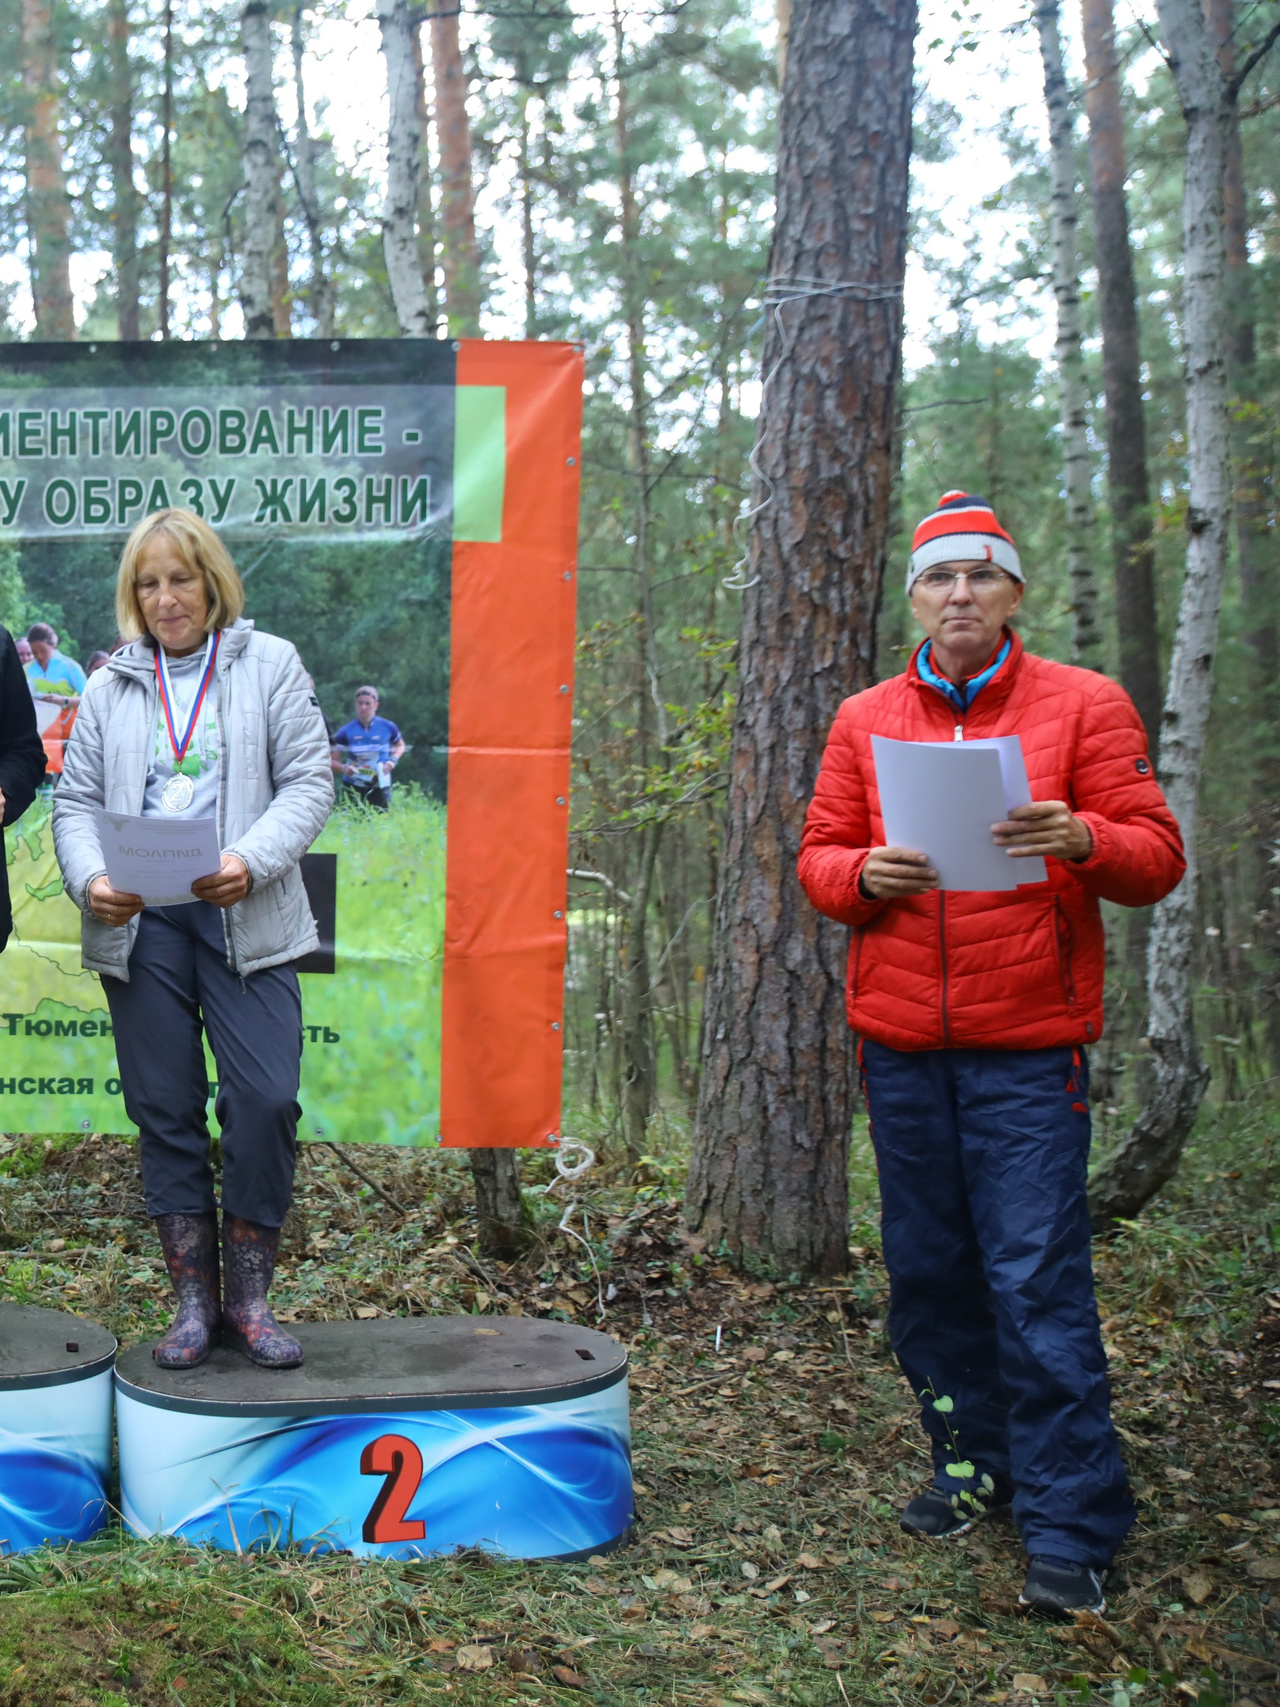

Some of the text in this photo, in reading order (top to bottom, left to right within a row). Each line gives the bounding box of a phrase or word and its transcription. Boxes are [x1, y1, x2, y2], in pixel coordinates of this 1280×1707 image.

[44, 477, 237, 525] ОБРАЗУ
[253, 477, 431, 524] ЖИЗНИ
[2, 1013, 115, 1038] Тюмен
[360, 1433, 426, 1544] 2
